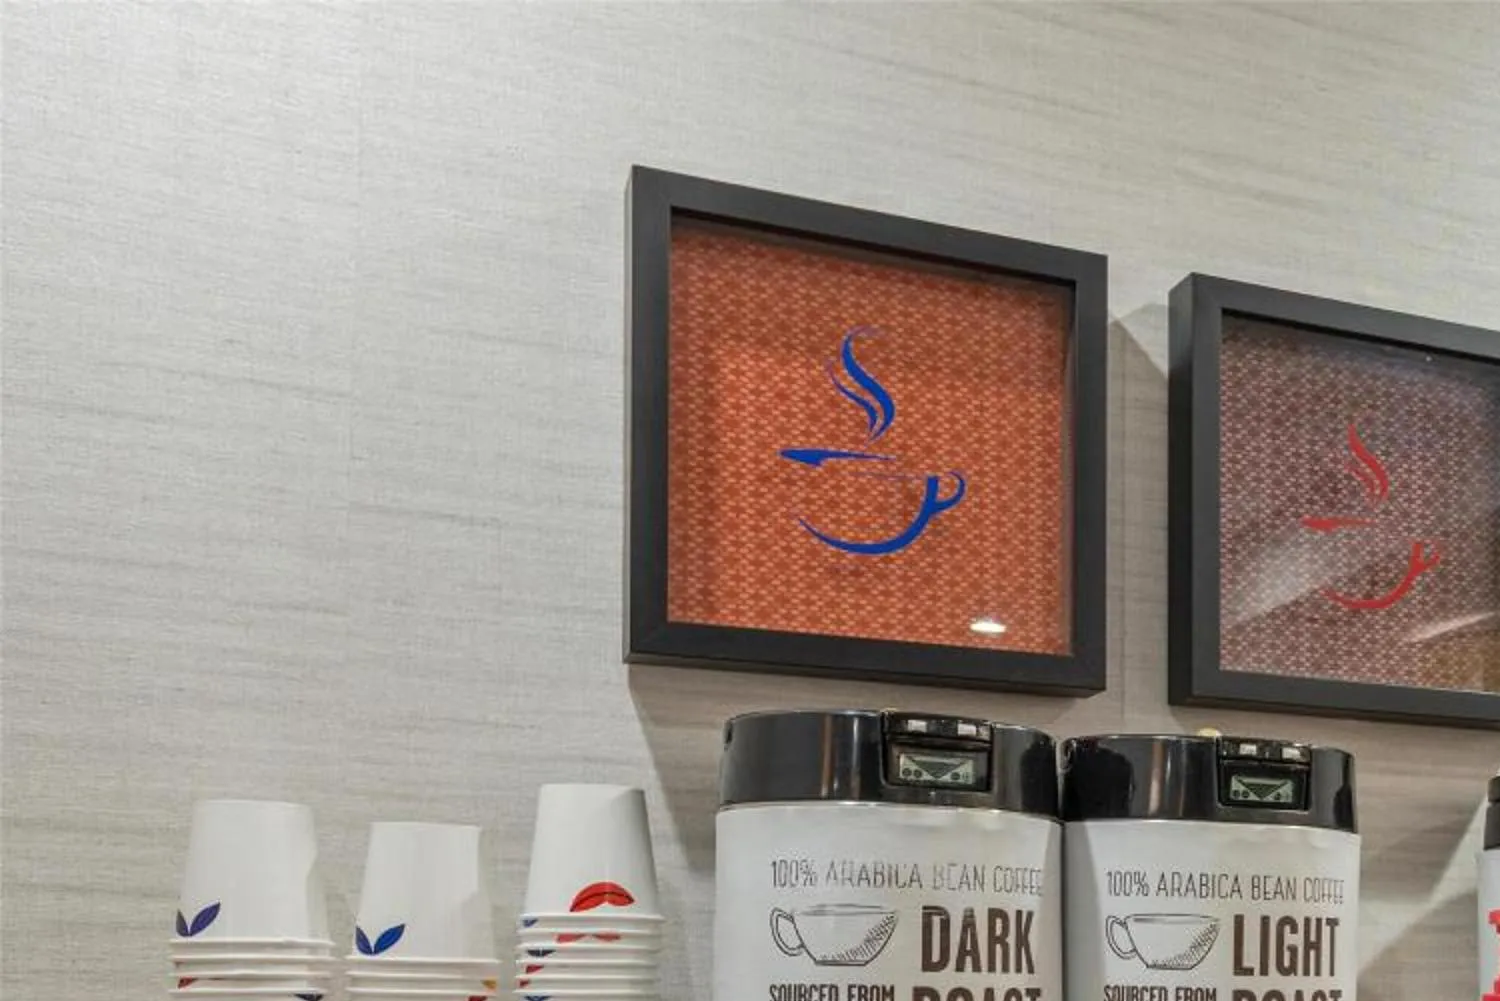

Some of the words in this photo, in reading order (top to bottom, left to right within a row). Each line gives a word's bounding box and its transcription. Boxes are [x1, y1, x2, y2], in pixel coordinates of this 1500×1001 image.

[771, 859, 818, 888] 100%
[825, 860, 923, 891] ARABICA
[934, 864, 985, 892] BEAN
[993, 866, 1044, 896] COFFEE
[1106, 870, 1149, 897] 100%
[1156, 872, 1243, 900] ARABICA
[1251, 875, 1296, 901] BEAN
[1303, 877, 1345, 904] COFFEE
[921, 905, 1035, 974] DARK
[1232, 914, 1340, 977] LIGHT
